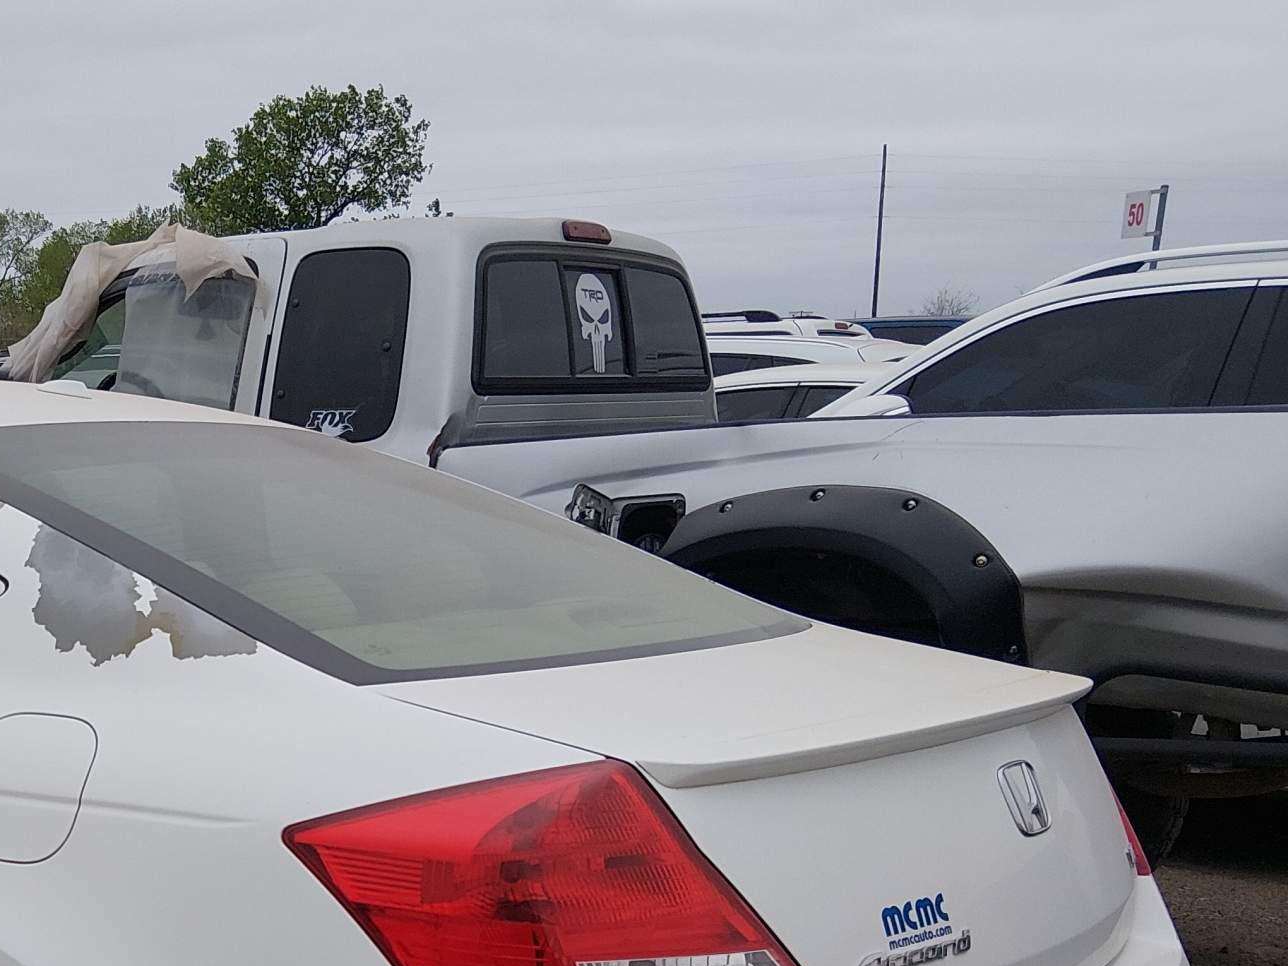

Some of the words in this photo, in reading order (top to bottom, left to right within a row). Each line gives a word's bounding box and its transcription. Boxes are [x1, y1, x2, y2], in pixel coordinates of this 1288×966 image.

[1127, 202, 1144, 227] 50
[581, 288, 604, 303] TRD
[305, 410, 356, 430] FOX
[889, 925, 953, 951] mcmcauto.com
